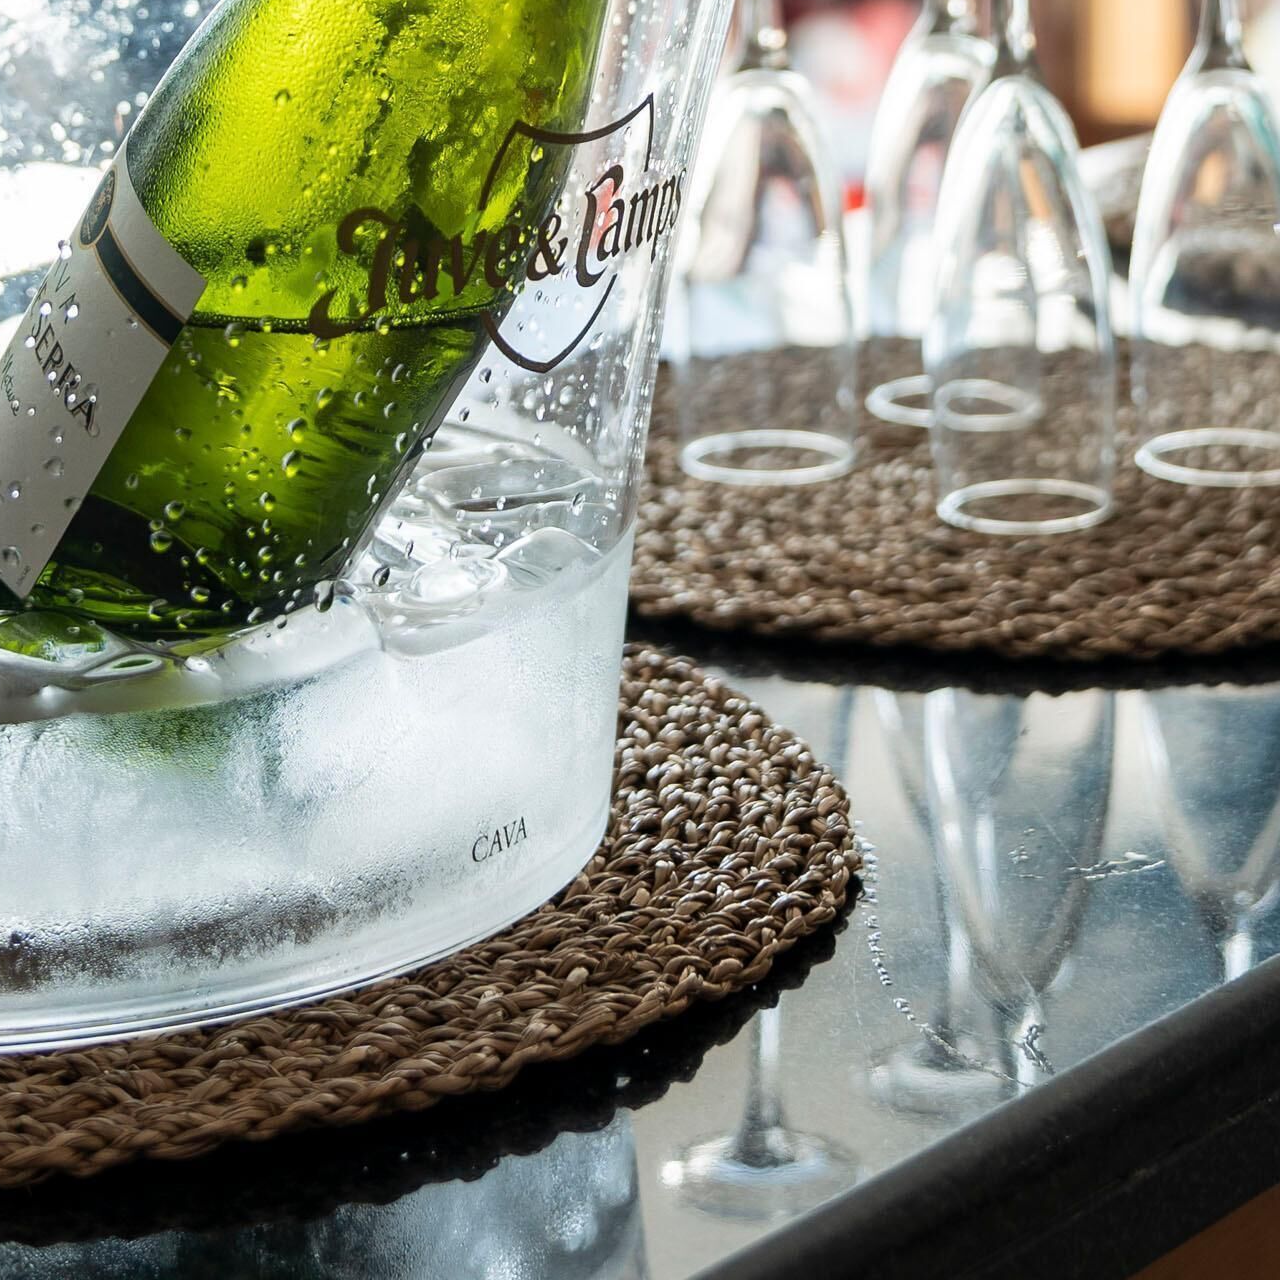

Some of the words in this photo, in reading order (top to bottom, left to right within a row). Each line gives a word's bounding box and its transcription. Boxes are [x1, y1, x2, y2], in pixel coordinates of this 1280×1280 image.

[526, 213, 569, 282] &
[576, 164, 687, 287] Camps
[471, 816, 527, 863] CAVA
